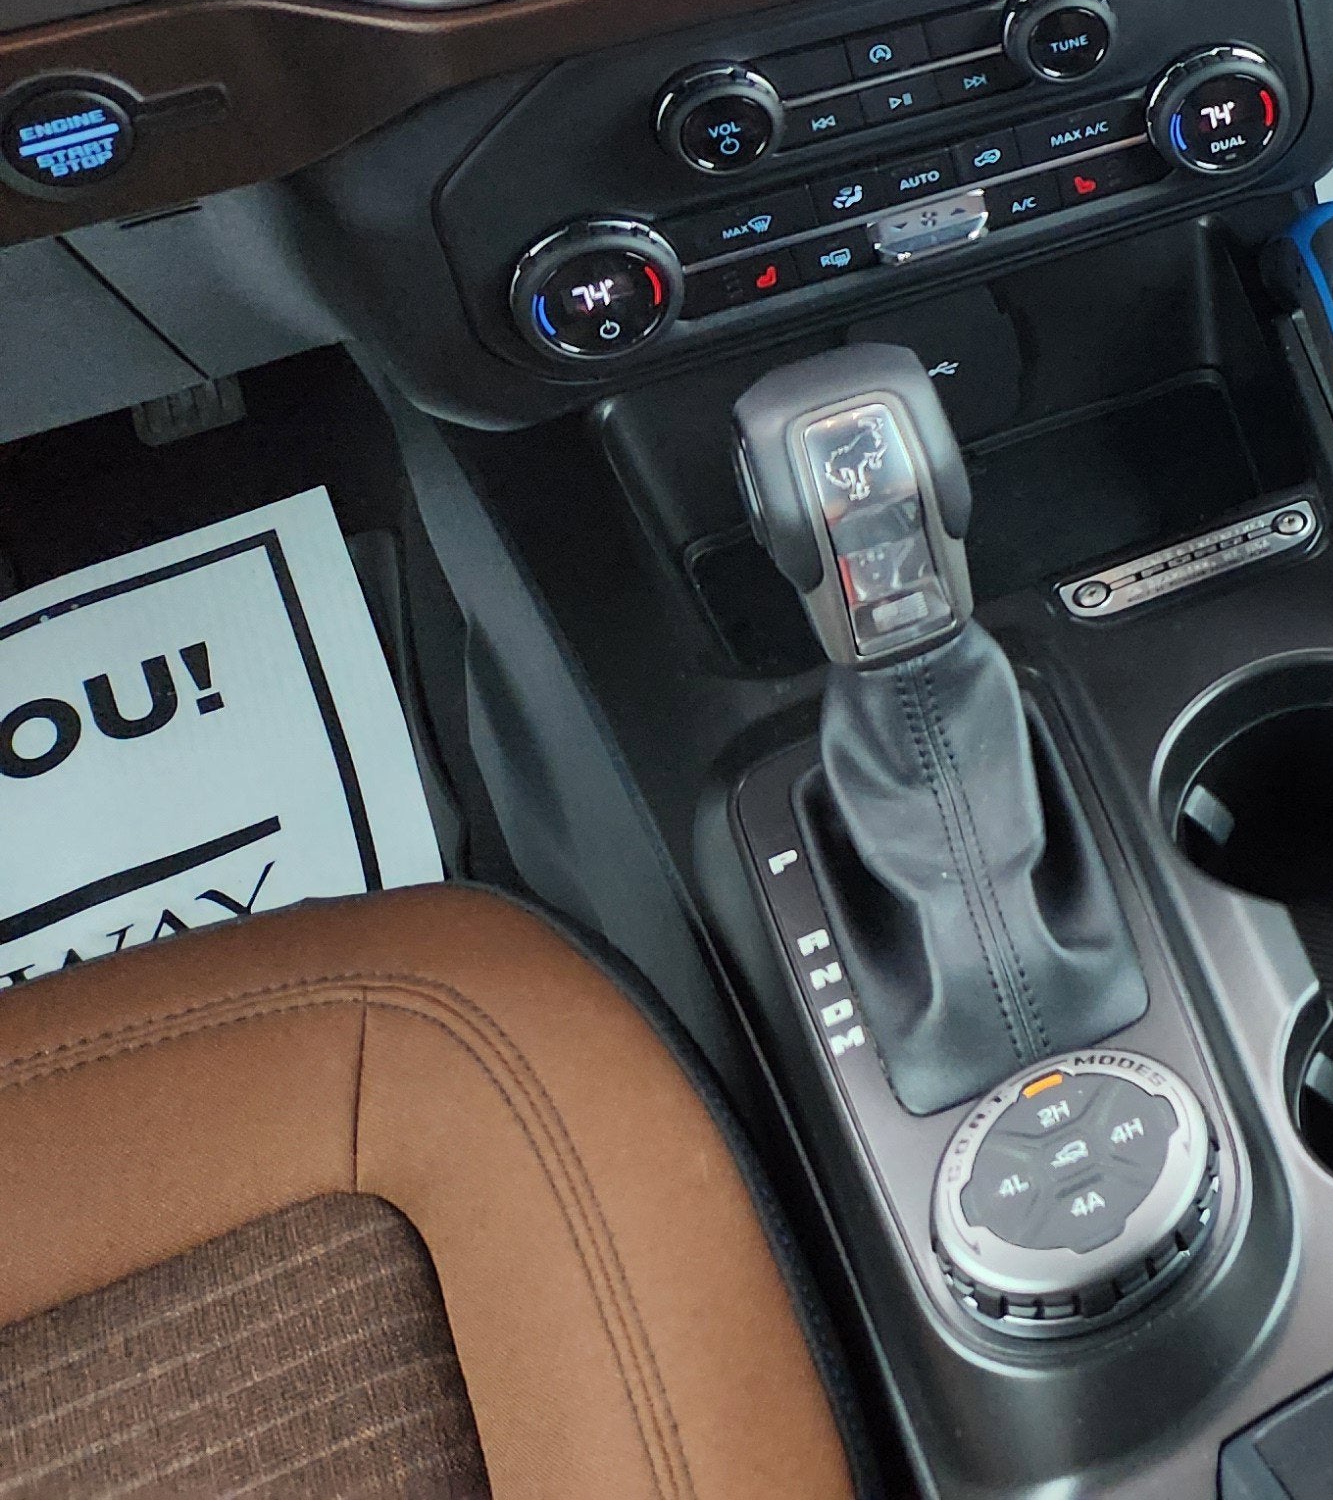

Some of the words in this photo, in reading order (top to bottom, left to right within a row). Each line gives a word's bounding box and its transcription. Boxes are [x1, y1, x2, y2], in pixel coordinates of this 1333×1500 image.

[1050, 34, 1090, 54] TUNE
[19, 109, 106, 142] ENGINE
[707, 121, 742, 138] VOL
[1050, 130, 1082, 147] MAX
[1085, 121, 1109, 138] A/C
[37, 137, 114, 169] START
[1211, 135, 1247, 154] DUAL
[50, 150, 113, 178] STOP
[900, 170, 940, 190] AUTO
[1012, 196, 1038, 213] A/C
[722, 224, 749, 240] MAX
[768, 849, 798, 876] P
[796, 928, 830, 957] R
[809, 961, 843, 991] N
[820, 998, 854, 1028] D
[830, 1025, 866, 1056] M
[1073, 1054, 1167, 1088] MODES
[1036, 1099, 1071, 1129] 2H
[1109, 1117, 1145, 1145] 4H
[997, 1173, 1031, 1198] 4L
[1070, 1191, 1106, 1218] 4A
